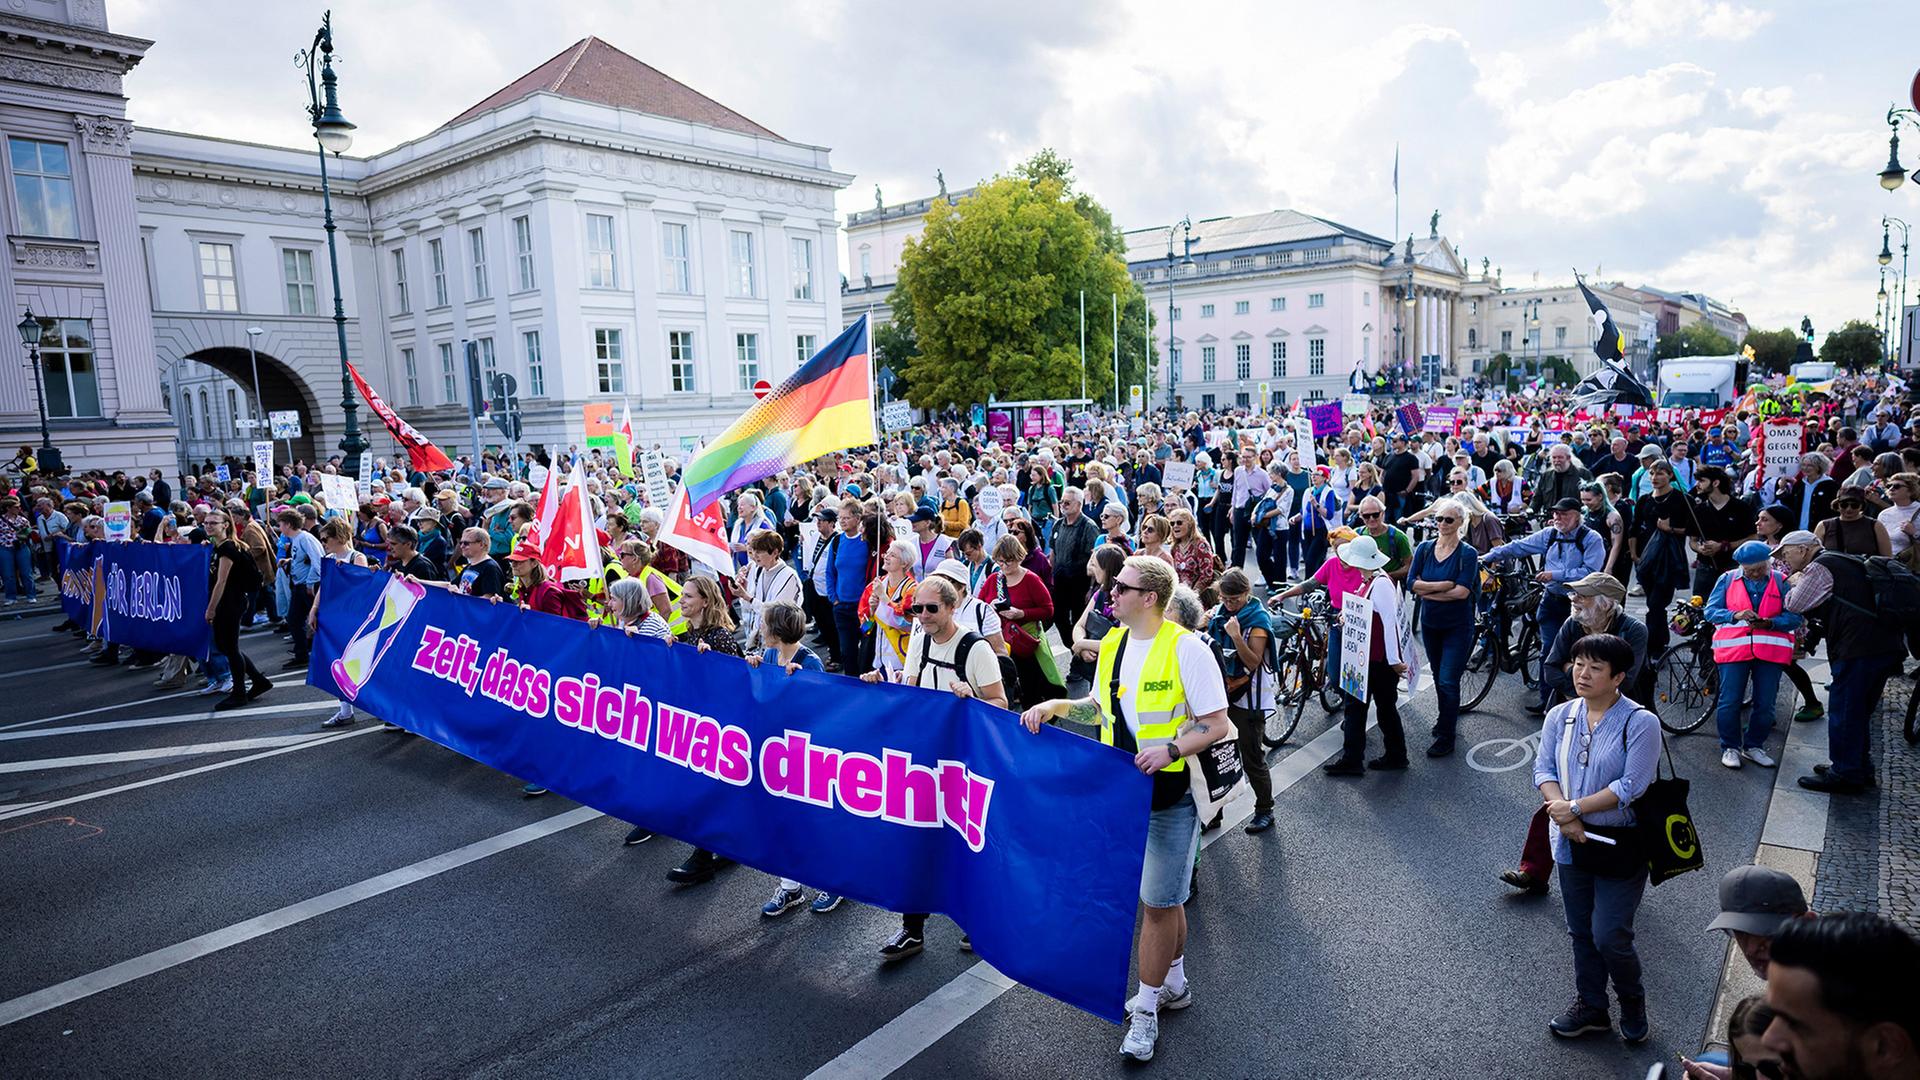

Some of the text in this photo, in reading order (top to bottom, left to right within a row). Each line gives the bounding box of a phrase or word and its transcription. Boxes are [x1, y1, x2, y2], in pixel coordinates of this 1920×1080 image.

[1769, 428, 1798, 437] OMAS
[1767, 442, 1799, 451] GEGEN
[1765, 456, 1800, 464] RECHTS
[130, 570, 182, 622] BERLIN
[1143, 679, 1174, 692] DBSH
[480, 647, 550, 718] dass
[554, 673, 651, 752] sich
[655, 702, 751, 786] was
[759, 729, 994, 852] dreht!
